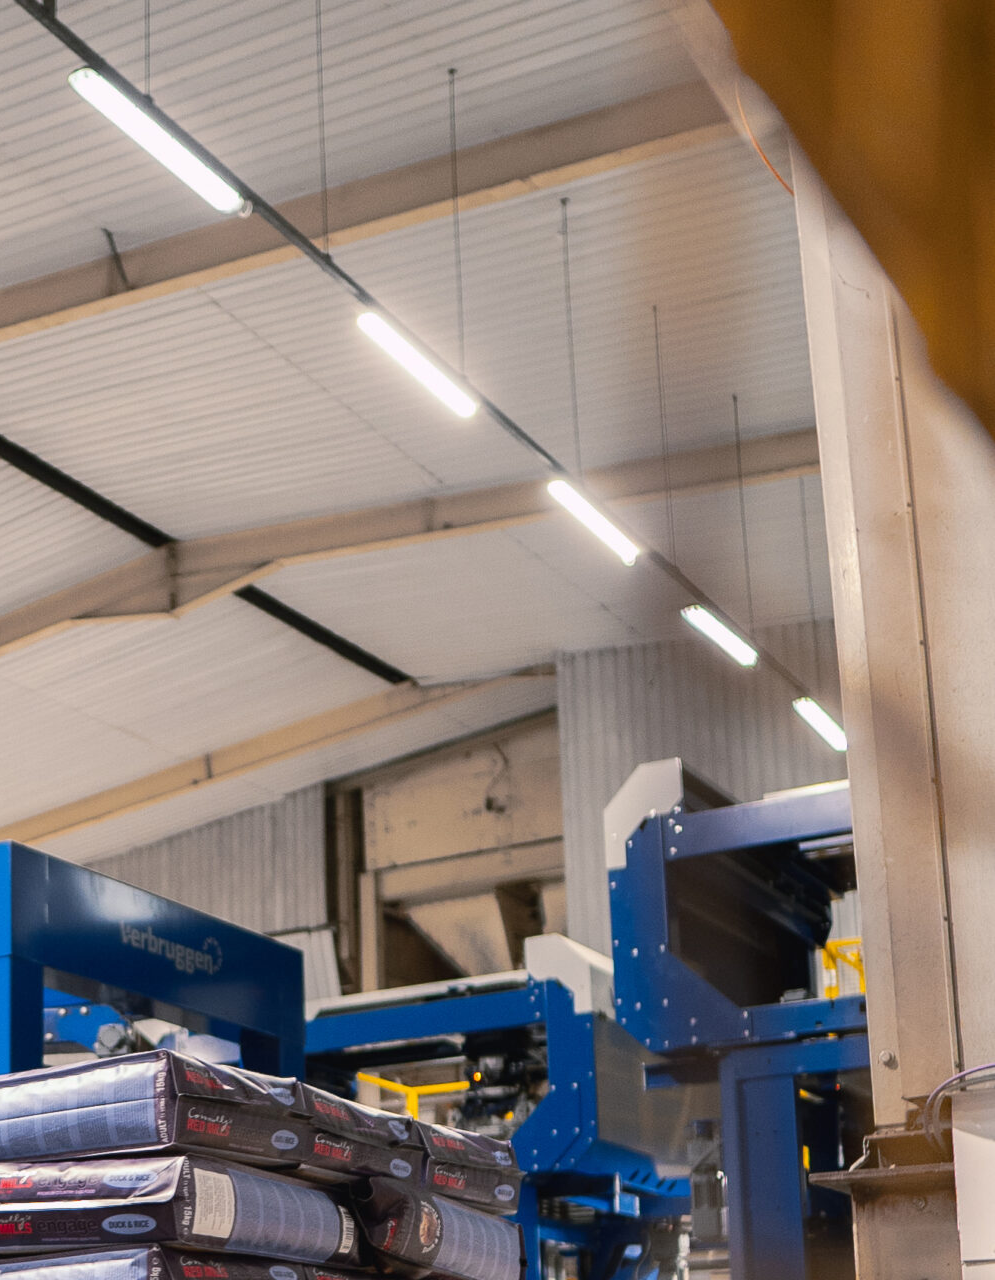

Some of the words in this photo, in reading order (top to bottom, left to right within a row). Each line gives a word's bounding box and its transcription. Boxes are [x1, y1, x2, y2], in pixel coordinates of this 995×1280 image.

[120, 921, 214, 975] Verbruggen
[157, 1071, 166, 1092] 15kg
[187, 1119, 205, 1132] RED
[188, 1107, 234, 1131] Connolly's
[158, 1120, 168, 1143] ADULT
[314, 1144, 332, 1156] RED
[37, 1173, 101, 1190] engage
[135, 1220, 150, 1228] RICE
[183, 1205, 192, 1231] 15kg
[0, 1222, 33, 1234] MILLS
[183, 1266, 204, 1278] RED
